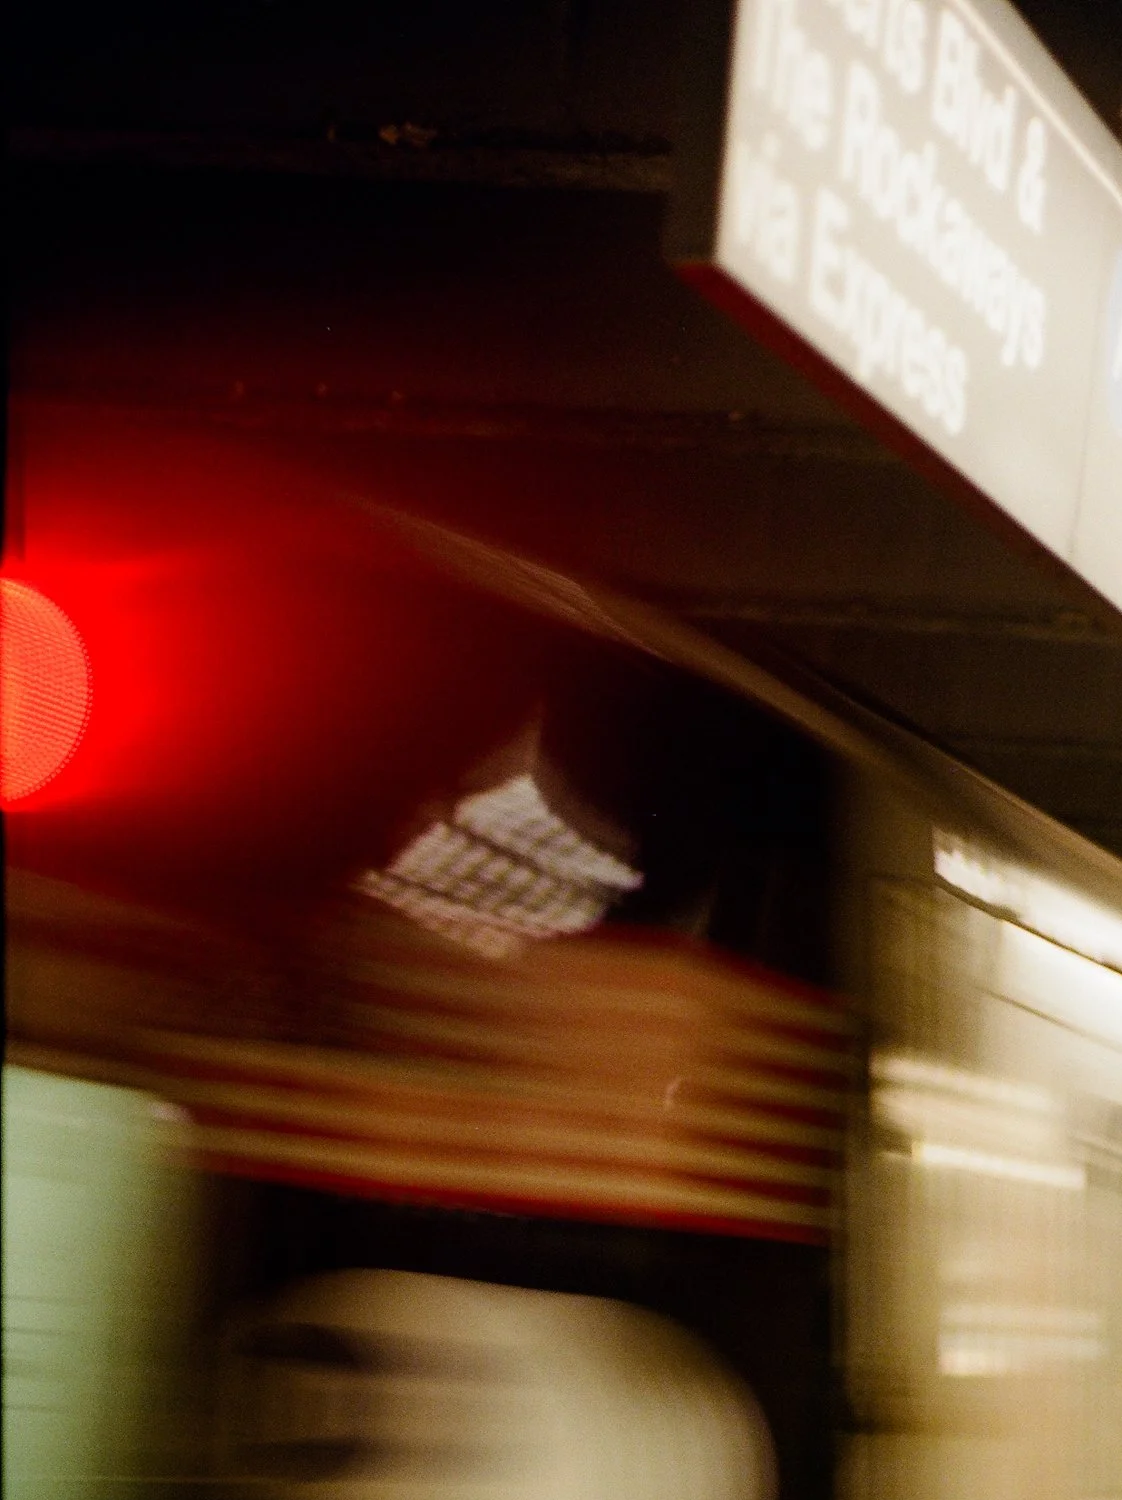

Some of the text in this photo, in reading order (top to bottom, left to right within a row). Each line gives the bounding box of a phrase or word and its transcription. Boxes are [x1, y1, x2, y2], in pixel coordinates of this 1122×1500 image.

[840, 59, 1046, 371] Rockaways
[931, 8, 1018, 193] Blvd
[1017, 116, 1046, 234] &
[809, 187, 968, 437] Express
